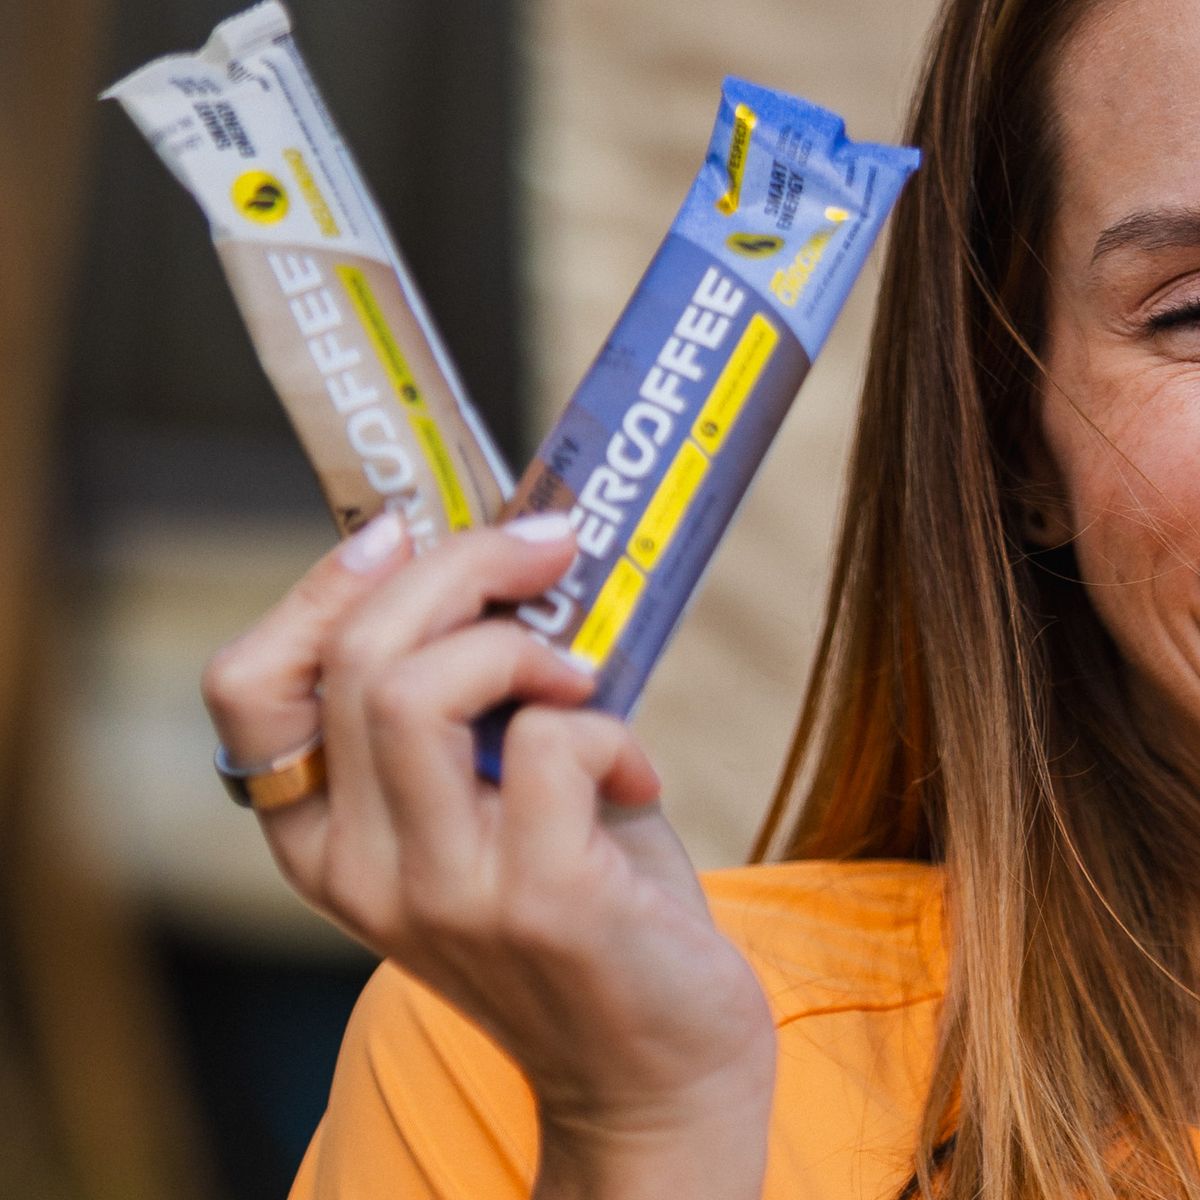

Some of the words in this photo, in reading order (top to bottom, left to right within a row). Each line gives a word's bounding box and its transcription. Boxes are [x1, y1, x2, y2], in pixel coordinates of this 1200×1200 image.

[763, 160, 788, 218] SMART
[775, 170, 804, 232] ENERGY
[515, 265, 746, 648] UERCOFFEE
